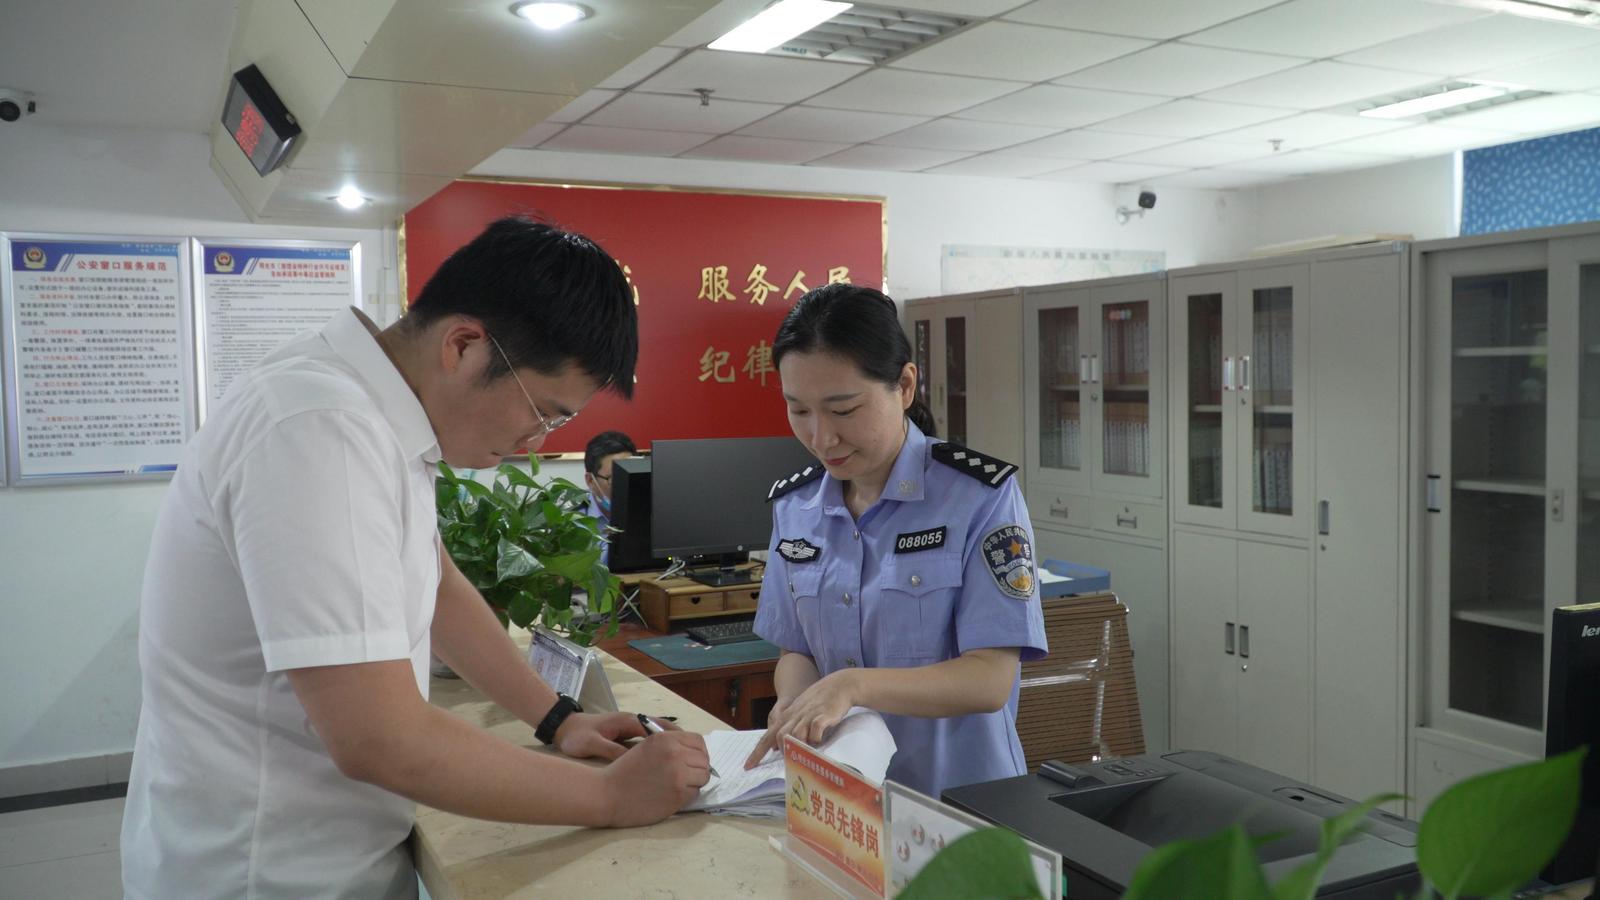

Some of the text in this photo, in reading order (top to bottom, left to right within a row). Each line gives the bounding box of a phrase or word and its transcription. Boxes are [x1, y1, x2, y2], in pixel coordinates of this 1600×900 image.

[77, 260, 167, 272] 公安窗口服务规范
[698, 339, 776, 387] 纪律
[898, 531, 943, 549] 088055
[810, 790, 879, 859] 党员先锋岗
